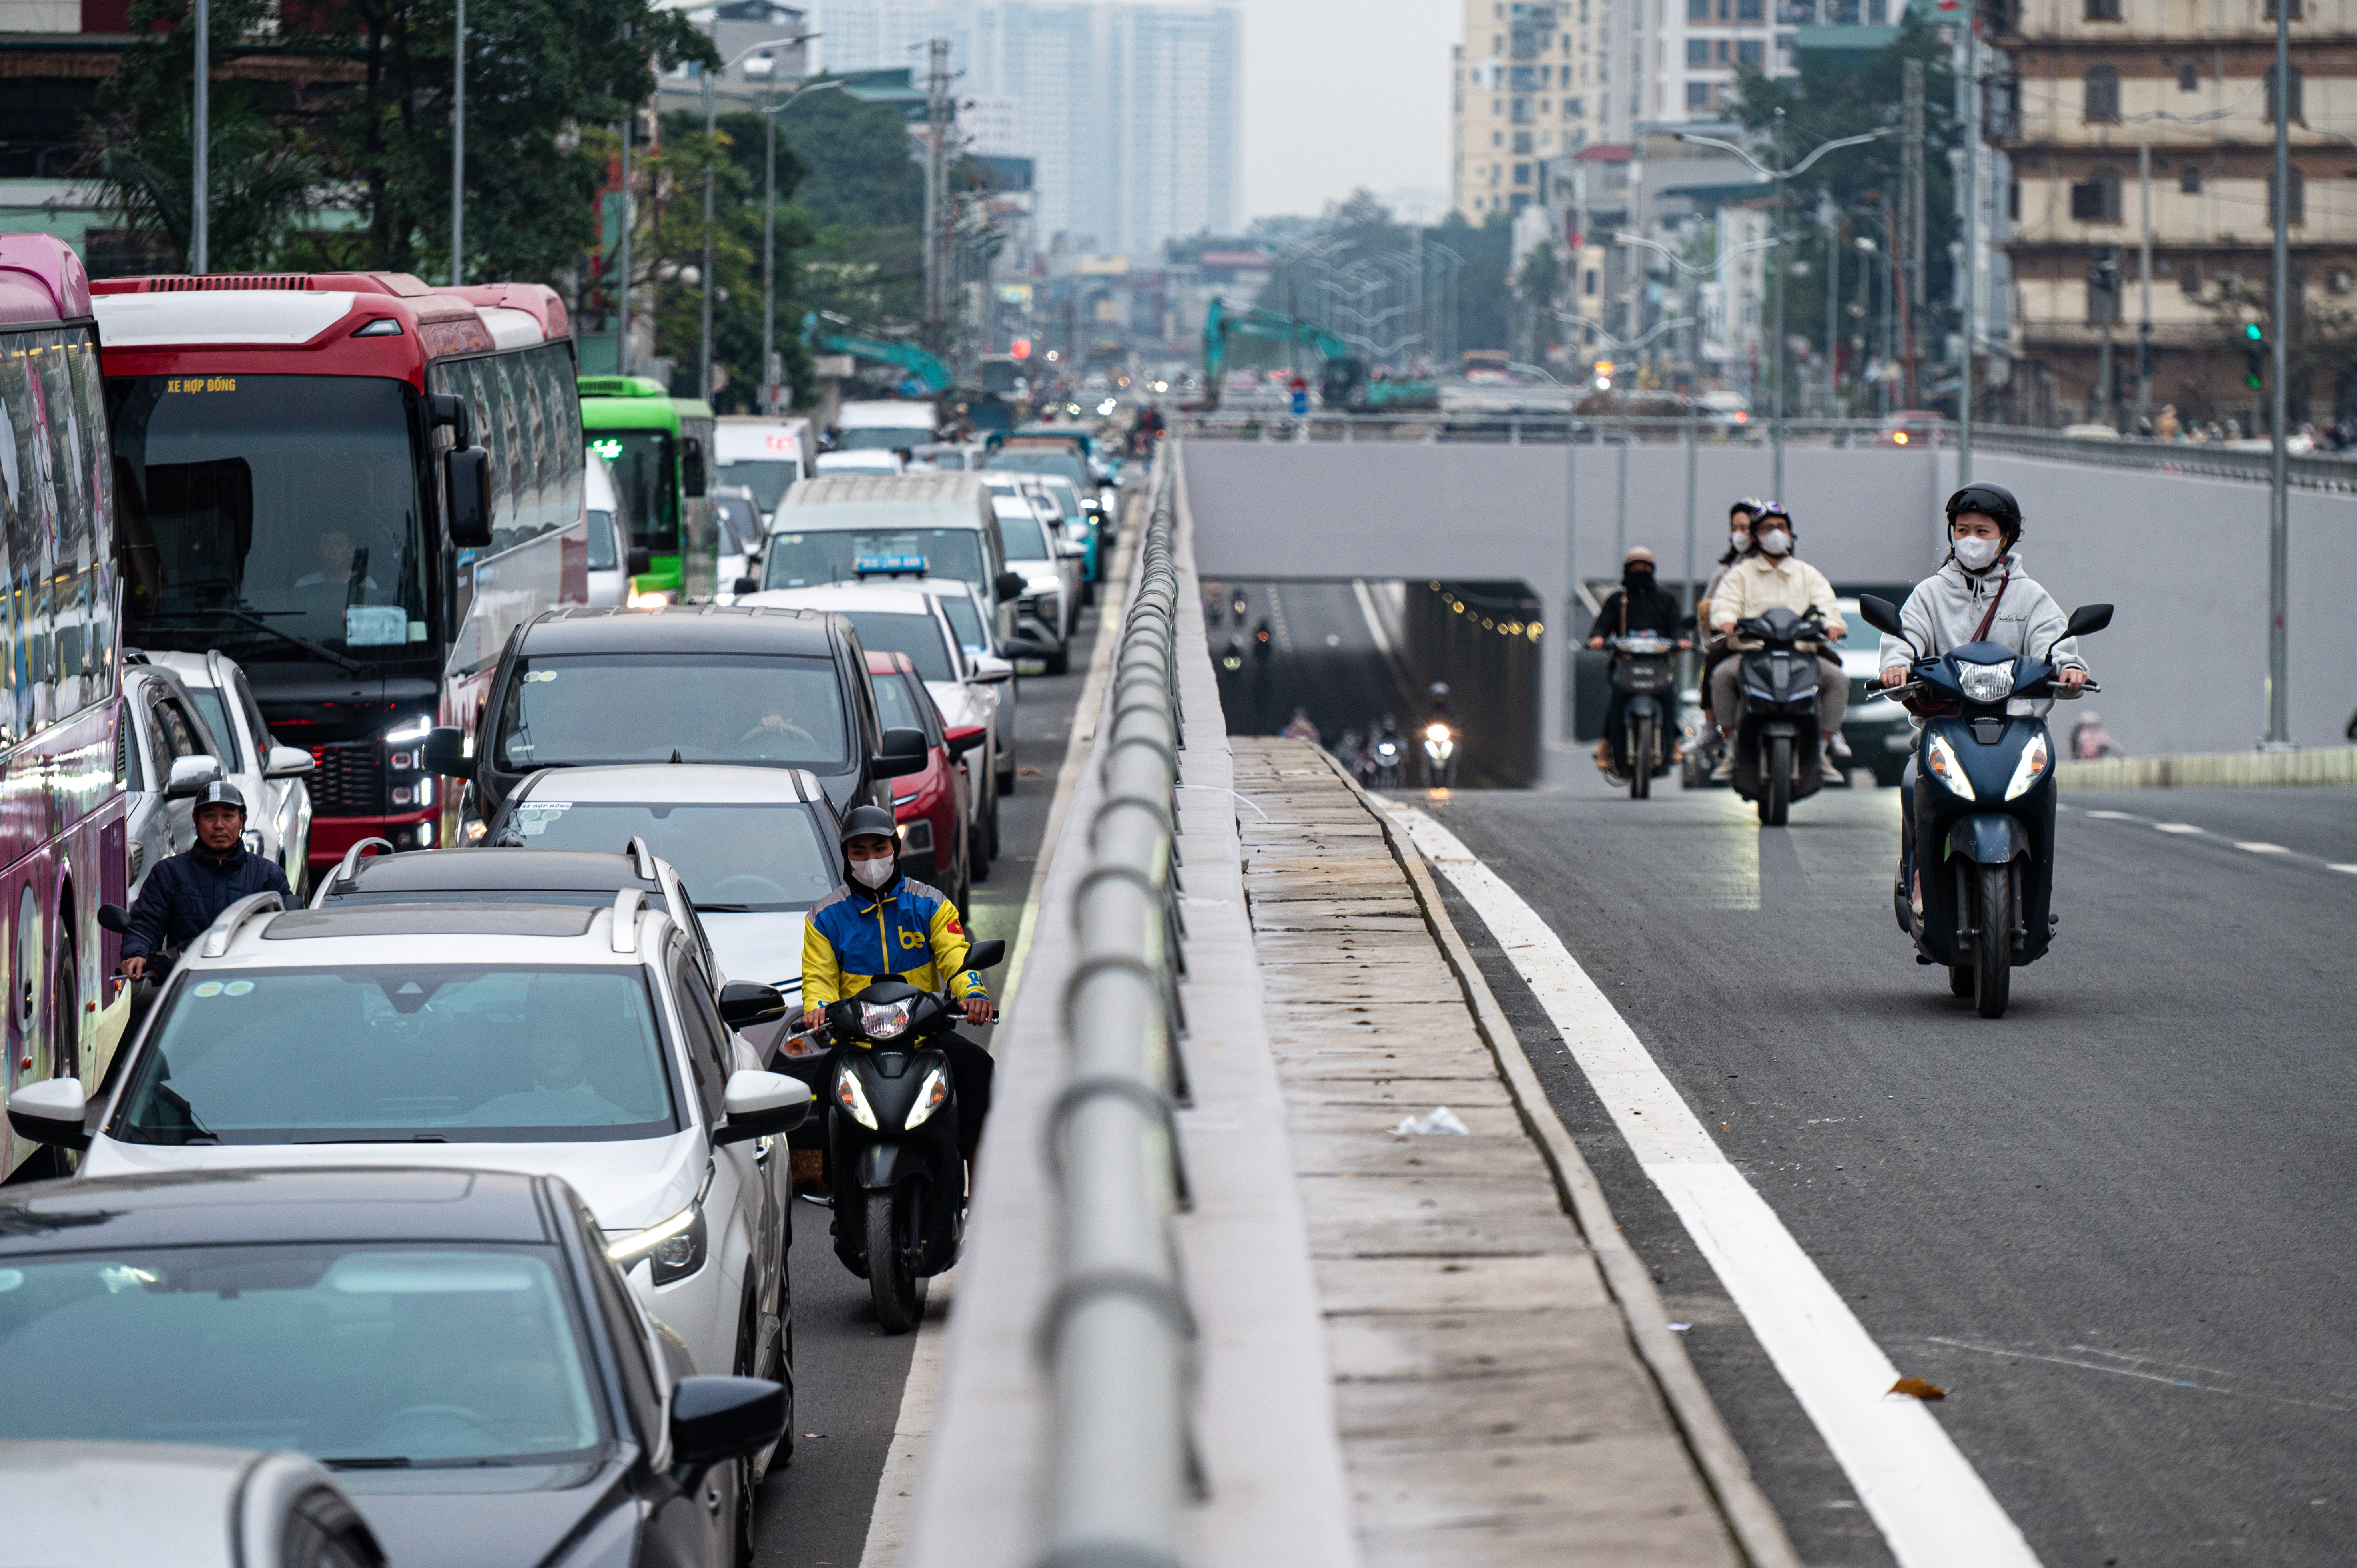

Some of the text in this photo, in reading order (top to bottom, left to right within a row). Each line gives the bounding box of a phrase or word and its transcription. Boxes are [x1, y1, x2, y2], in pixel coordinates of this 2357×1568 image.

[168, 380, 181, 392] XE
[183, 378, 204, 394] HỢP
[898, 925, 925, 950] be
